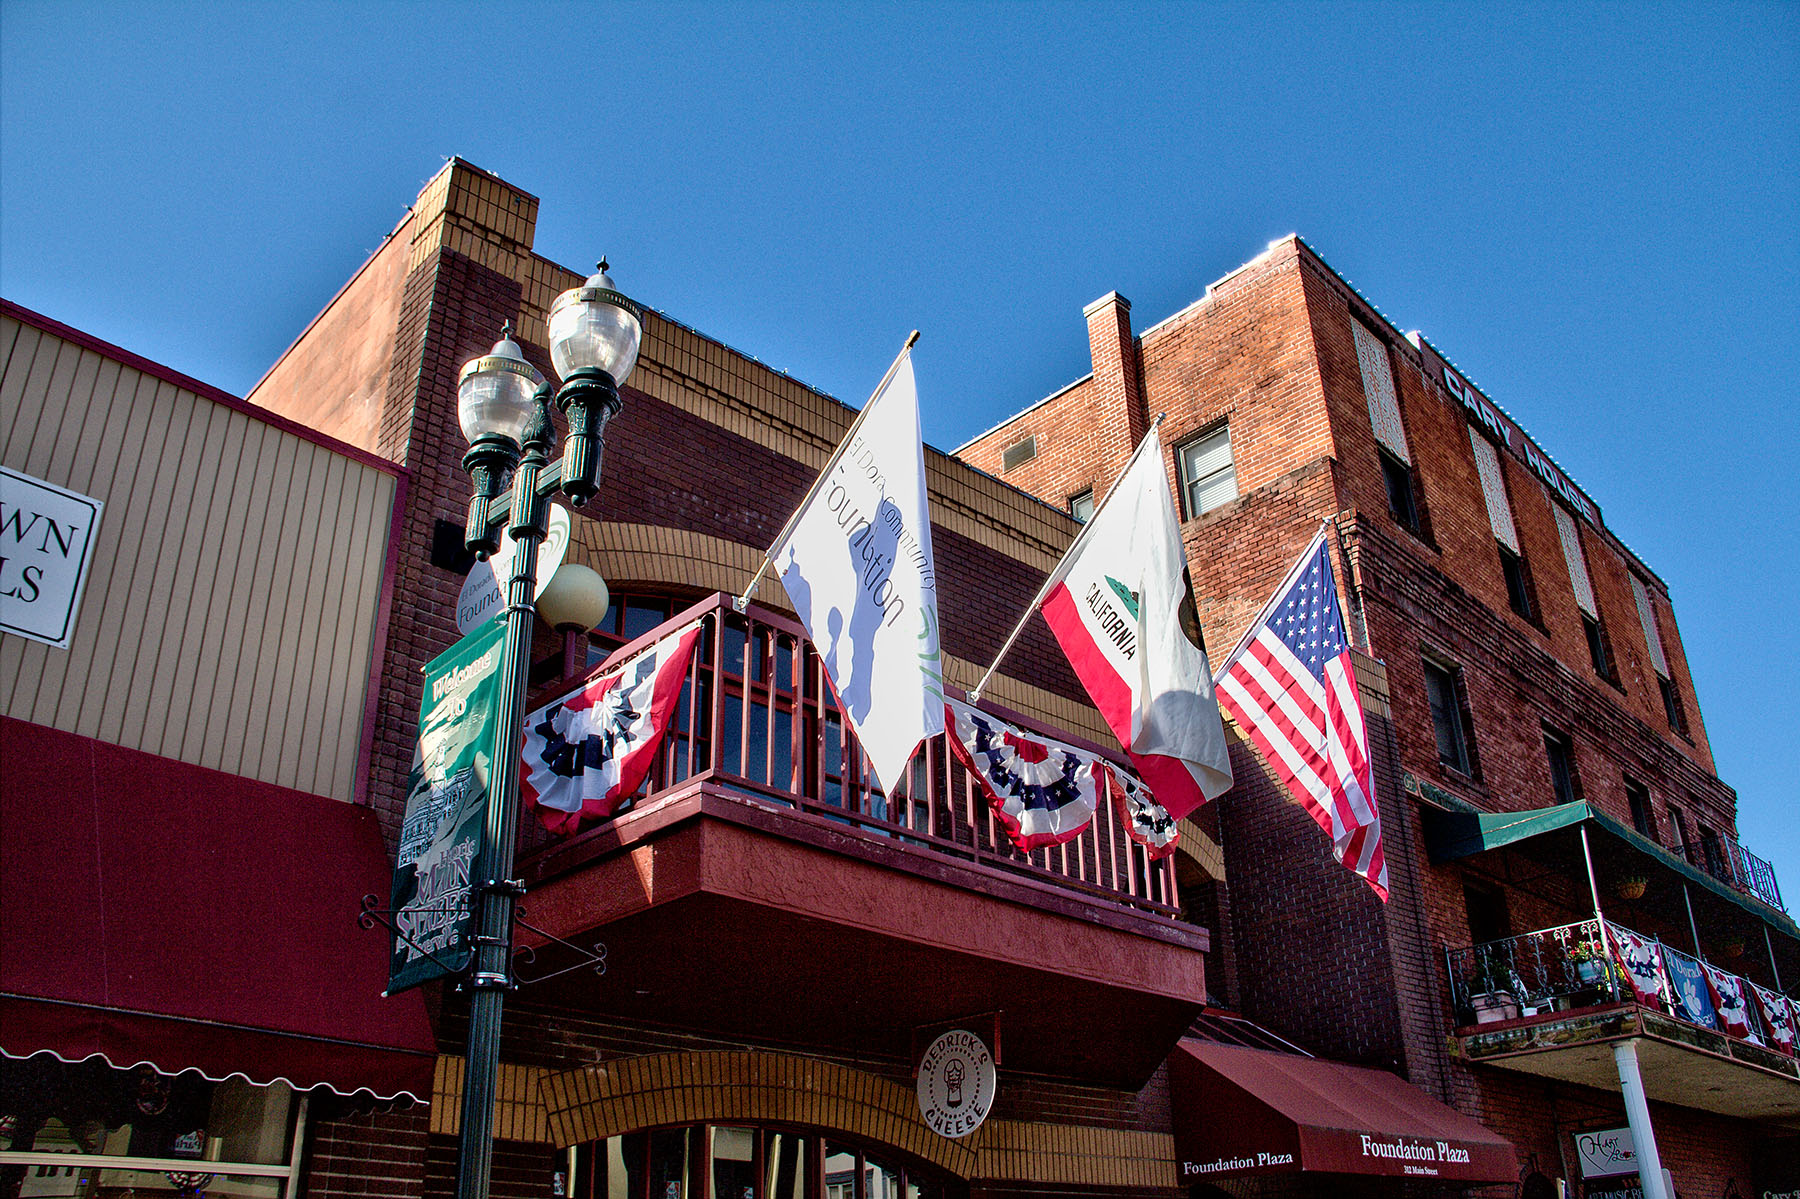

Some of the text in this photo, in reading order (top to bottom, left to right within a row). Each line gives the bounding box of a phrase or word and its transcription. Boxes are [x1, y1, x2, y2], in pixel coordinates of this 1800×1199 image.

[1444, 368, 1595, 525] CARY HOUSE
[1086, 582, 1136, 661] CALIFORNIA
[432, 651, 492, 702] Welcome
[923, 1034, 988, 1072] DEDRICK'S
[925, 1102, 985, 1135] CHEESE
[1183, 1152, 1294, 1175] Foundation Plaza
[1361, 1134, 1470, 1163] Foundation Plaza
[1412, 1165, 1424, 1175] Main
[1424, 1166, 1438, 1175] Street
